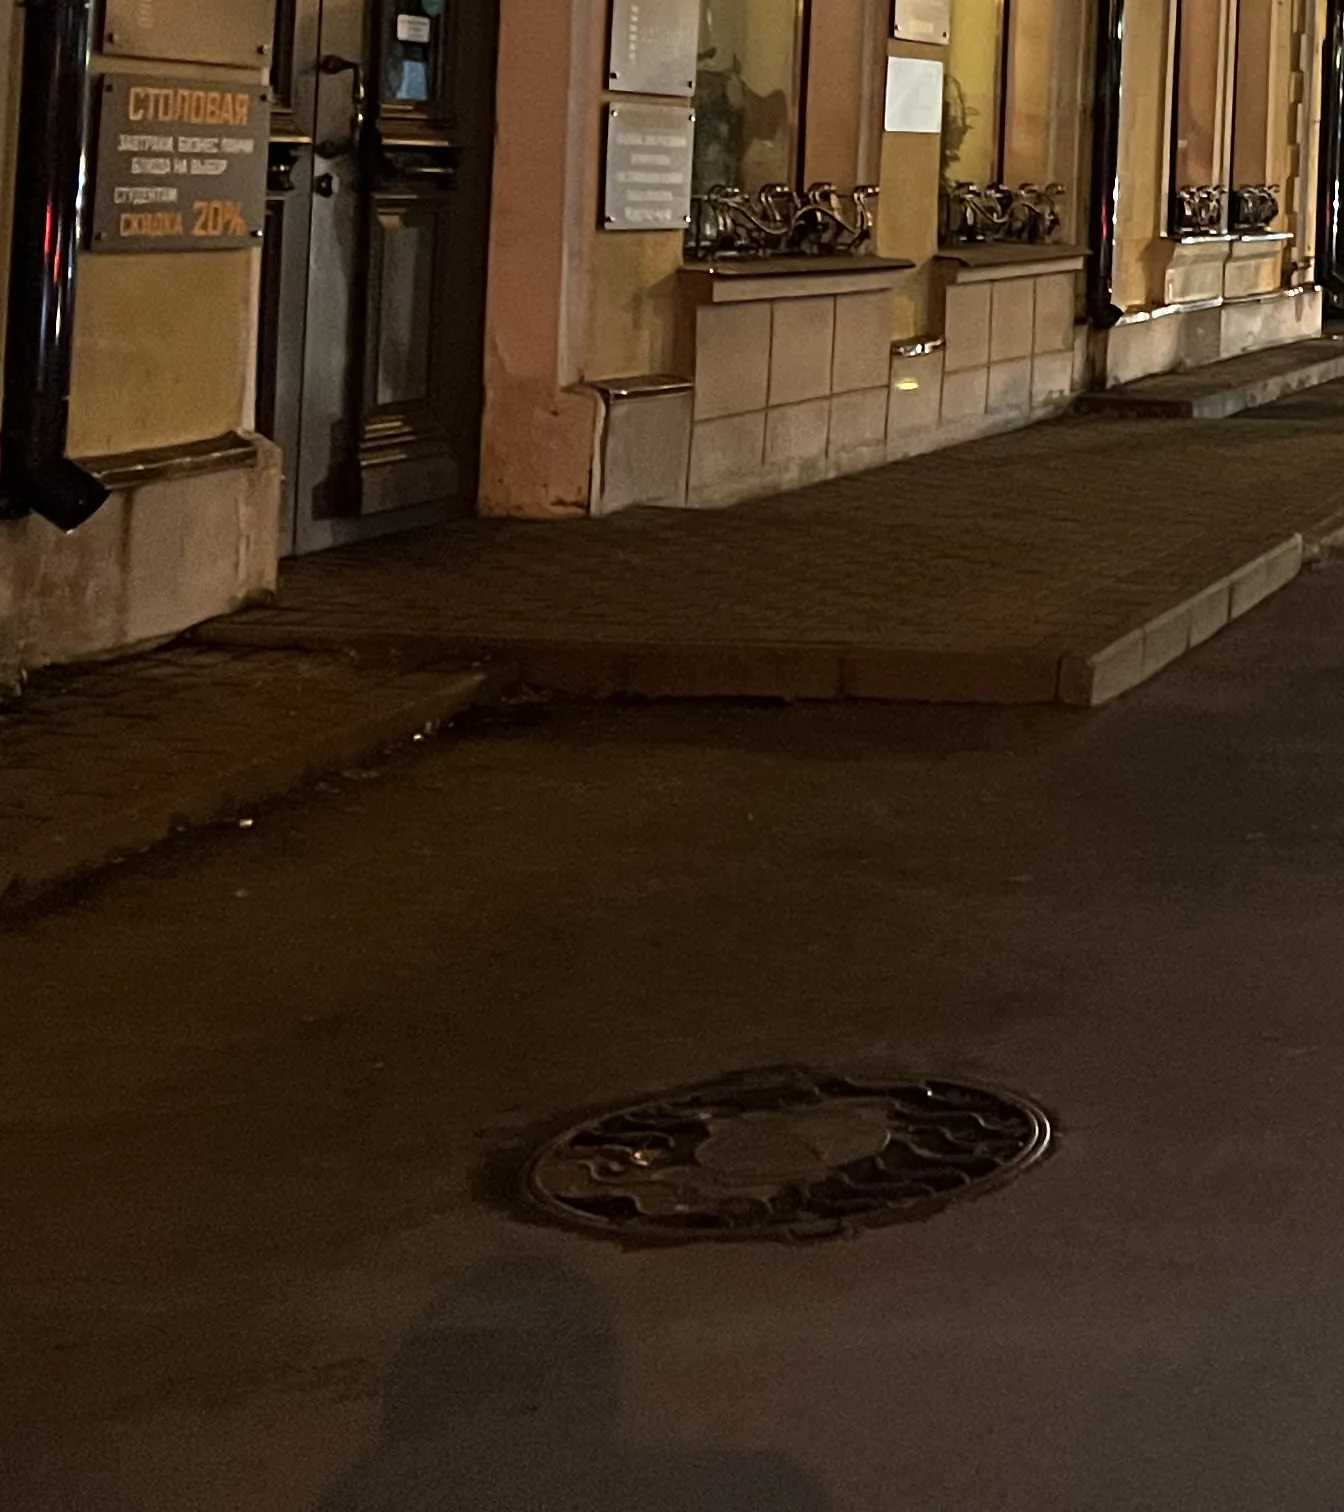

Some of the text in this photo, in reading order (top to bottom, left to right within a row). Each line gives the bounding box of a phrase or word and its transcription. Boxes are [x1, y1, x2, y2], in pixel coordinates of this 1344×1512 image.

[128, 87, 249, 126] СТОЛОВАЯ
[120, 200, 249, 237] СКИДКА 20%
